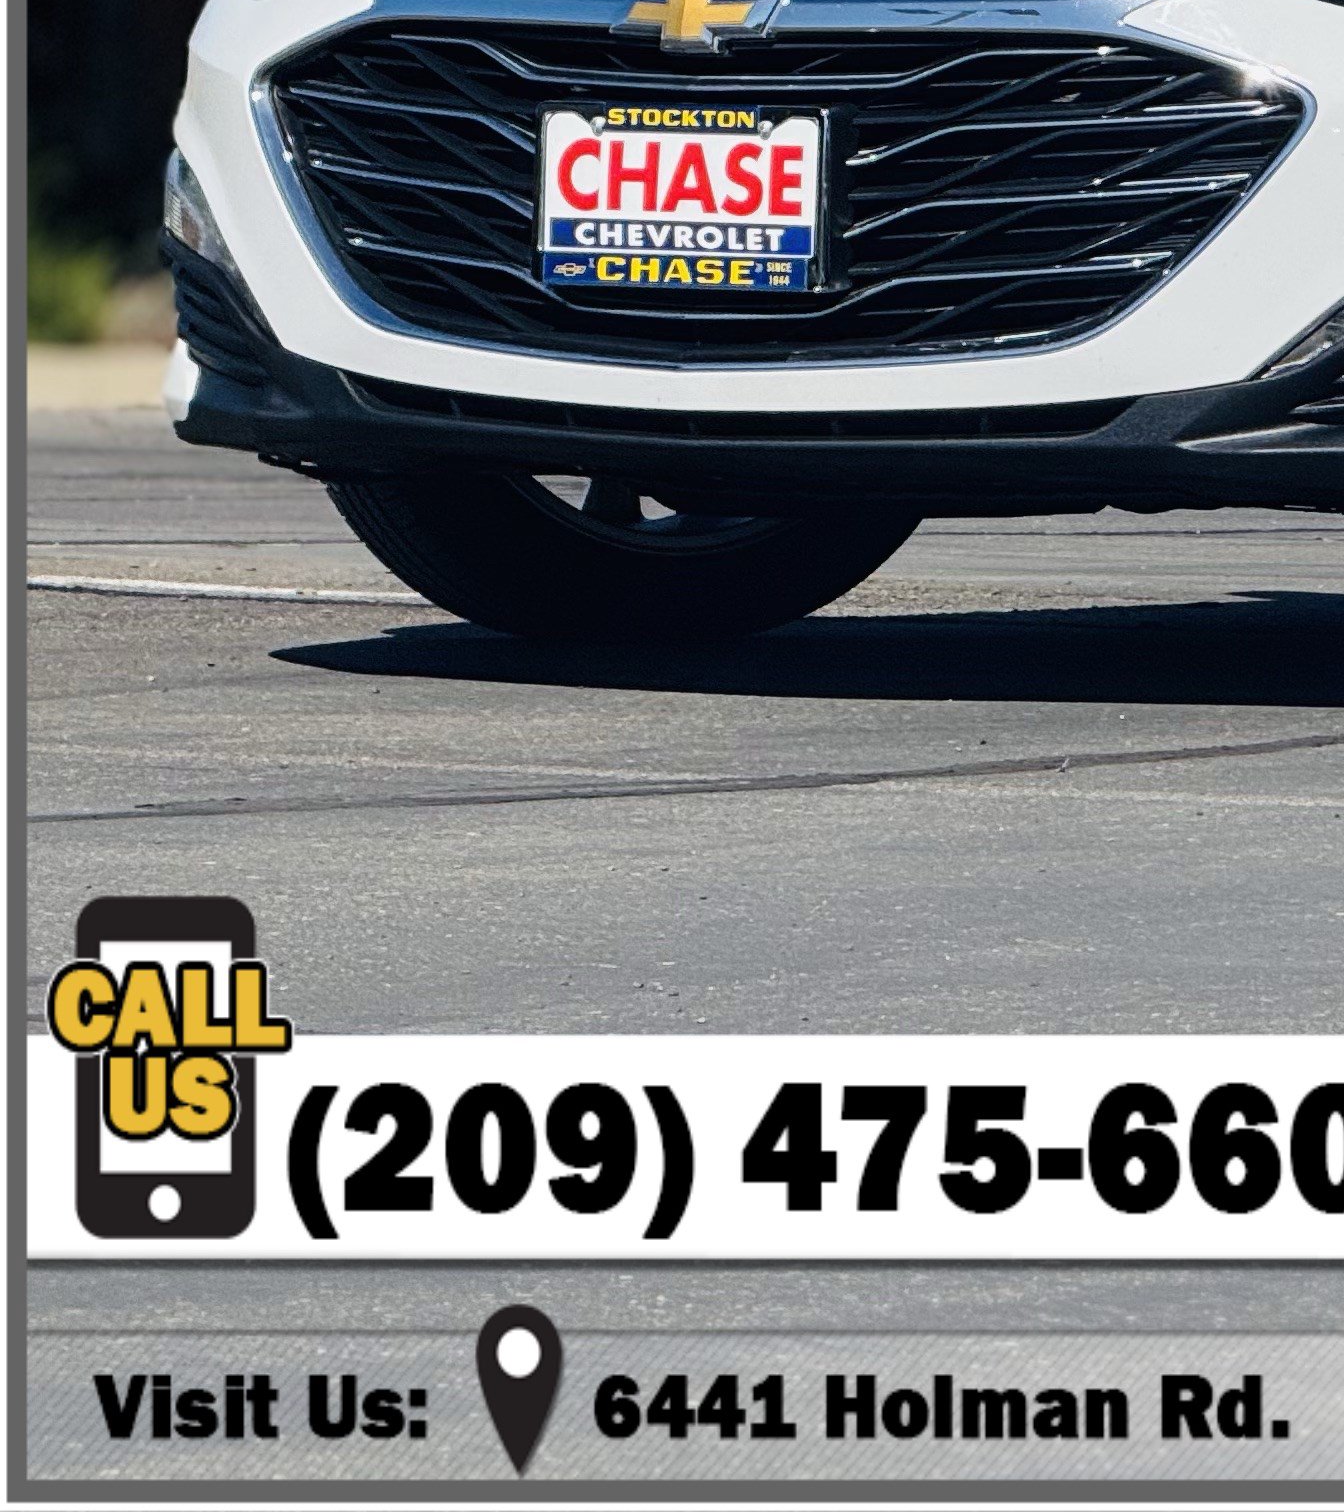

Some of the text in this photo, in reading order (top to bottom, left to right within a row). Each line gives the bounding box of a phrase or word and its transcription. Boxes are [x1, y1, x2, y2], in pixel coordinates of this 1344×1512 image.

[606, 107, 756, 130] STOCKTON
[556, 137, 805, 217] CHASE
[574, 222, 786, 252] CHEVROLET
[596, 255, 755, 286] CHASE
